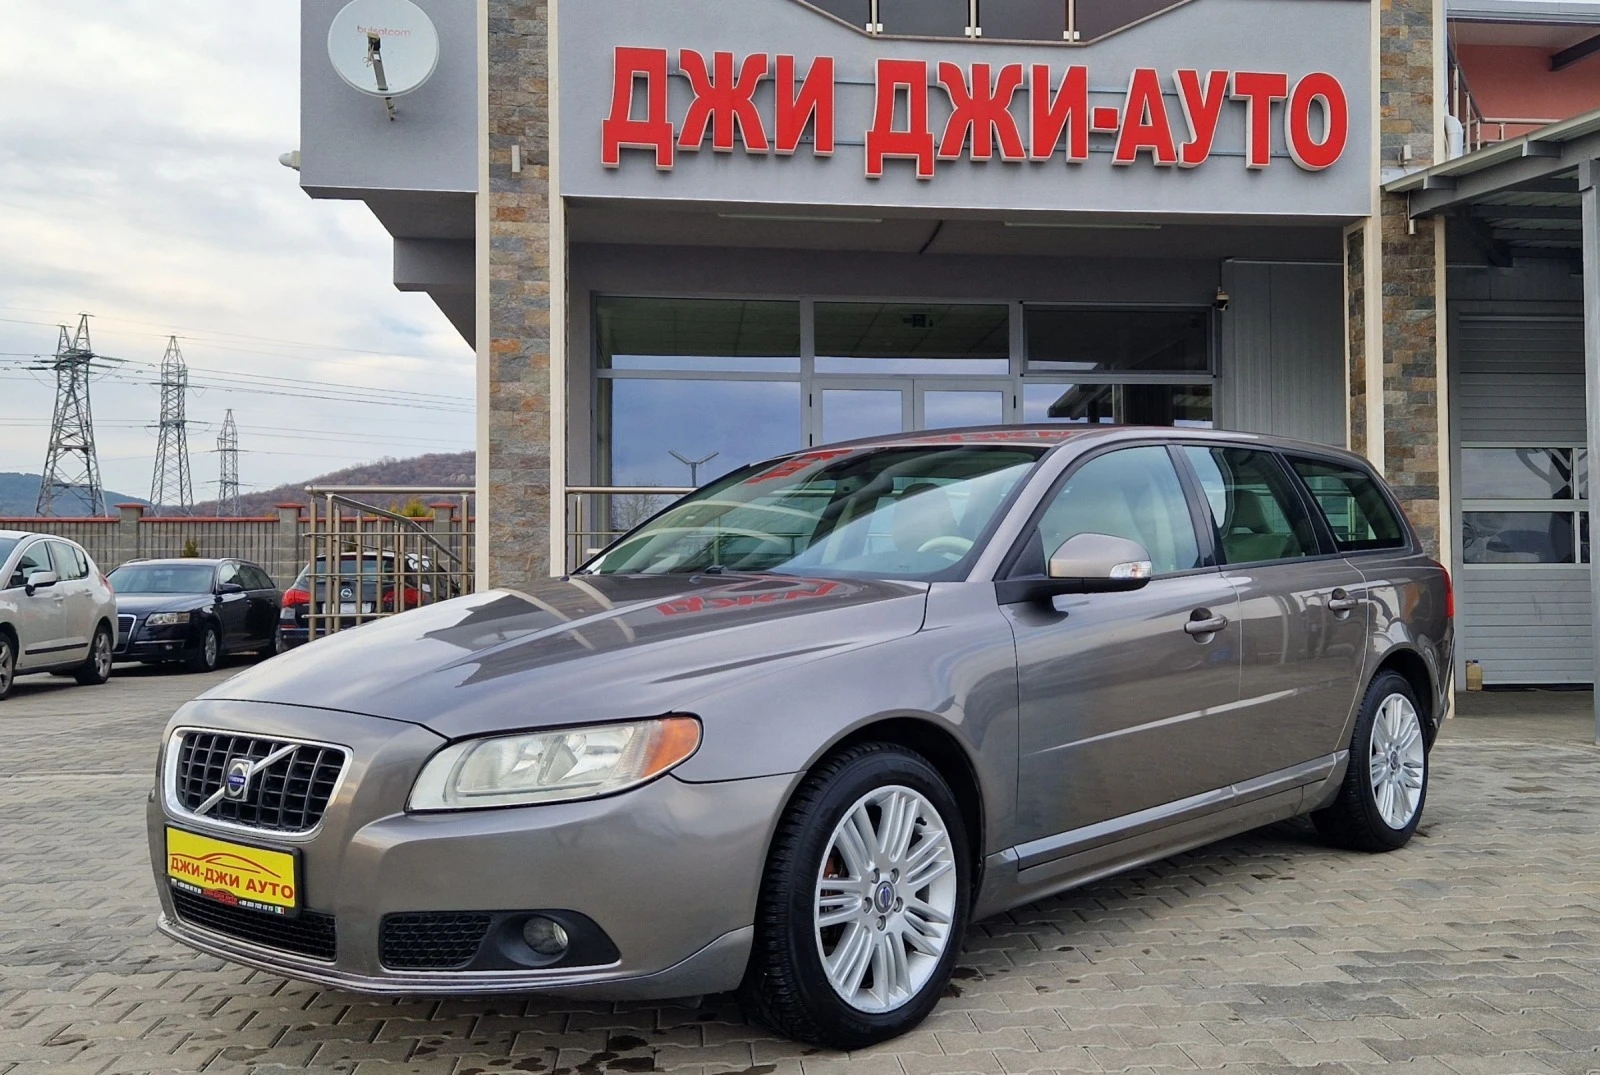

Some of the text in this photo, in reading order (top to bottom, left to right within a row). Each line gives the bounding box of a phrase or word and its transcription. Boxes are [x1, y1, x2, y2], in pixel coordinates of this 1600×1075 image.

[601, 46, 1349, 180] ДЖИ ДЖИ-АУТО
[171, 857, 240, 889] ДЖИ-ДЖИ
[245, 878, 294, 899] АУТО
